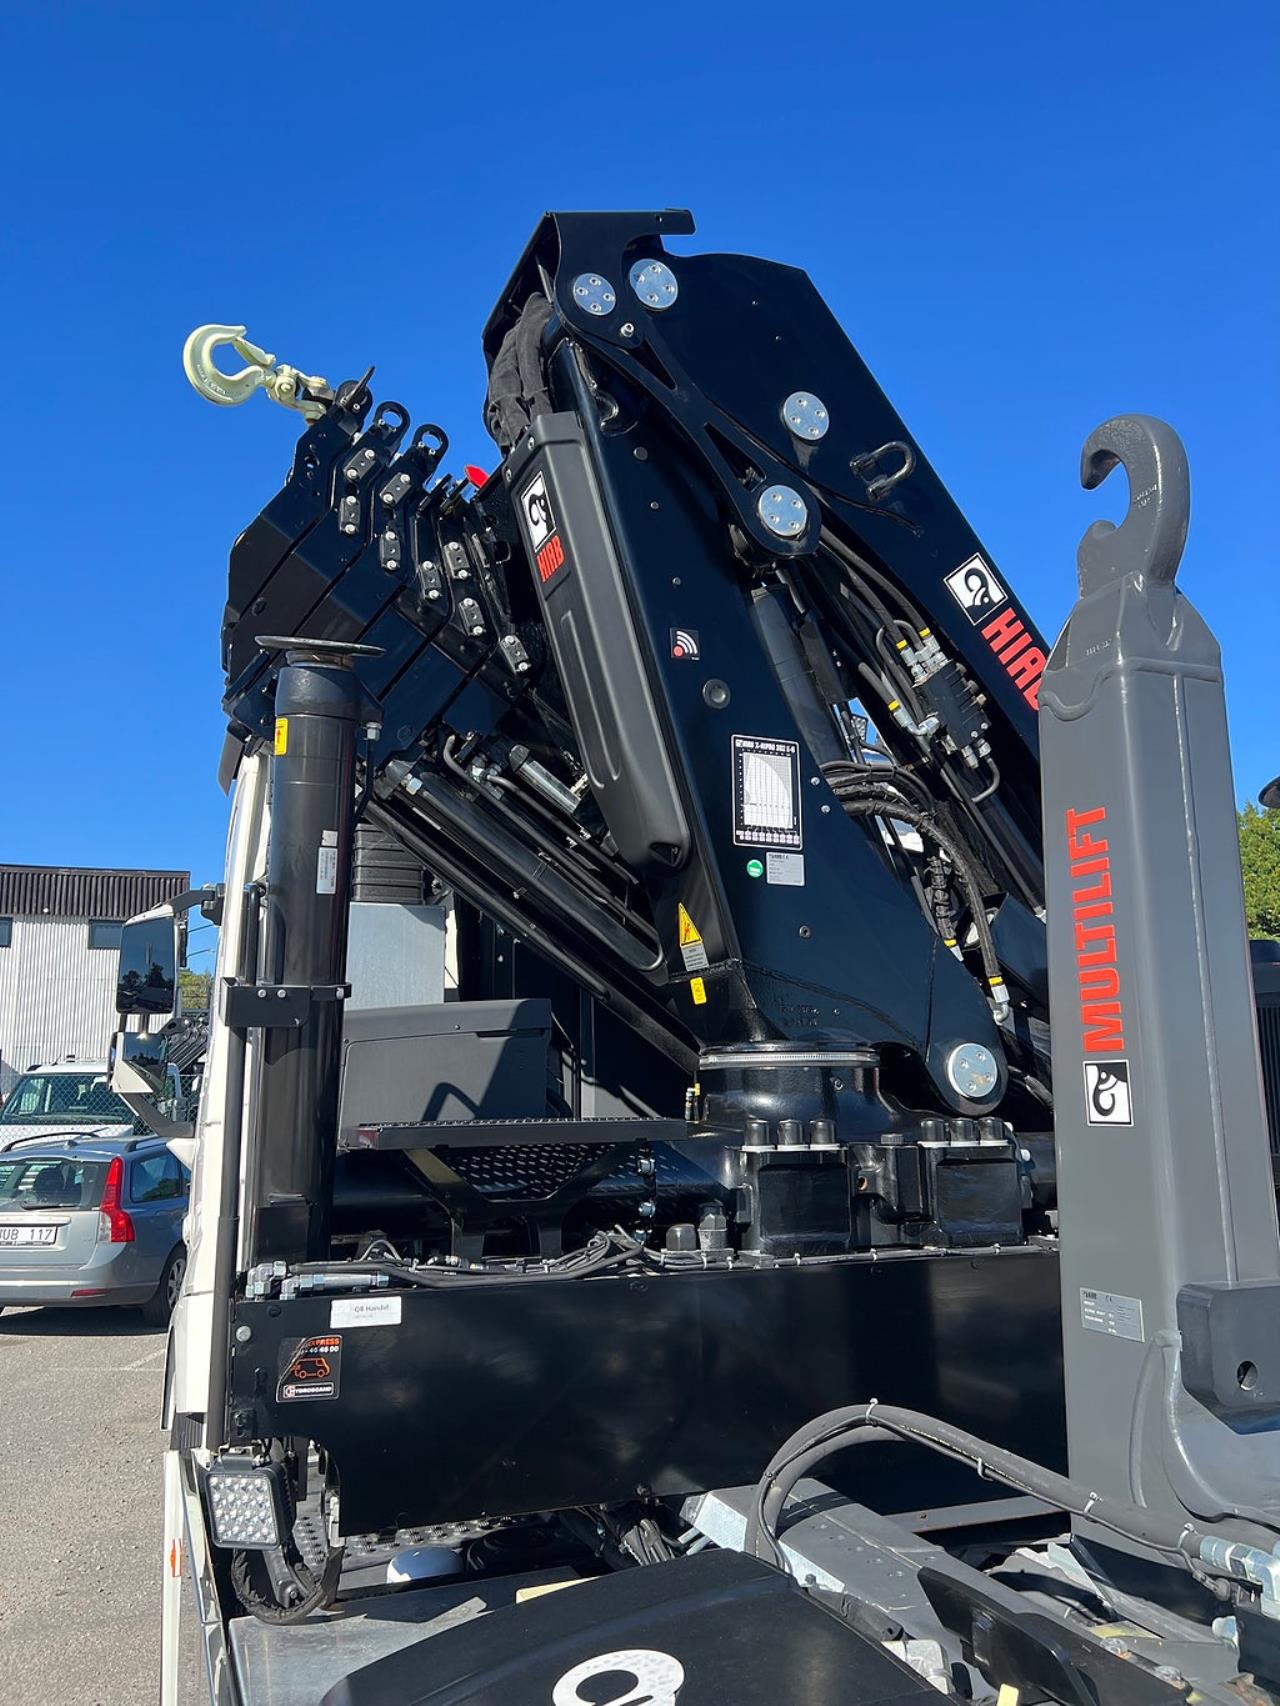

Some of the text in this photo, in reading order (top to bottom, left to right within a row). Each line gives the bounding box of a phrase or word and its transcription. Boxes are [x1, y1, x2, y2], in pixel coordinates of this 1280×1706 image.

[537, 536, 565, 583] HIAB
[1065, 806, 1124, 1052] MULTILIFT
[30, 1229, 53, 1240] 117
